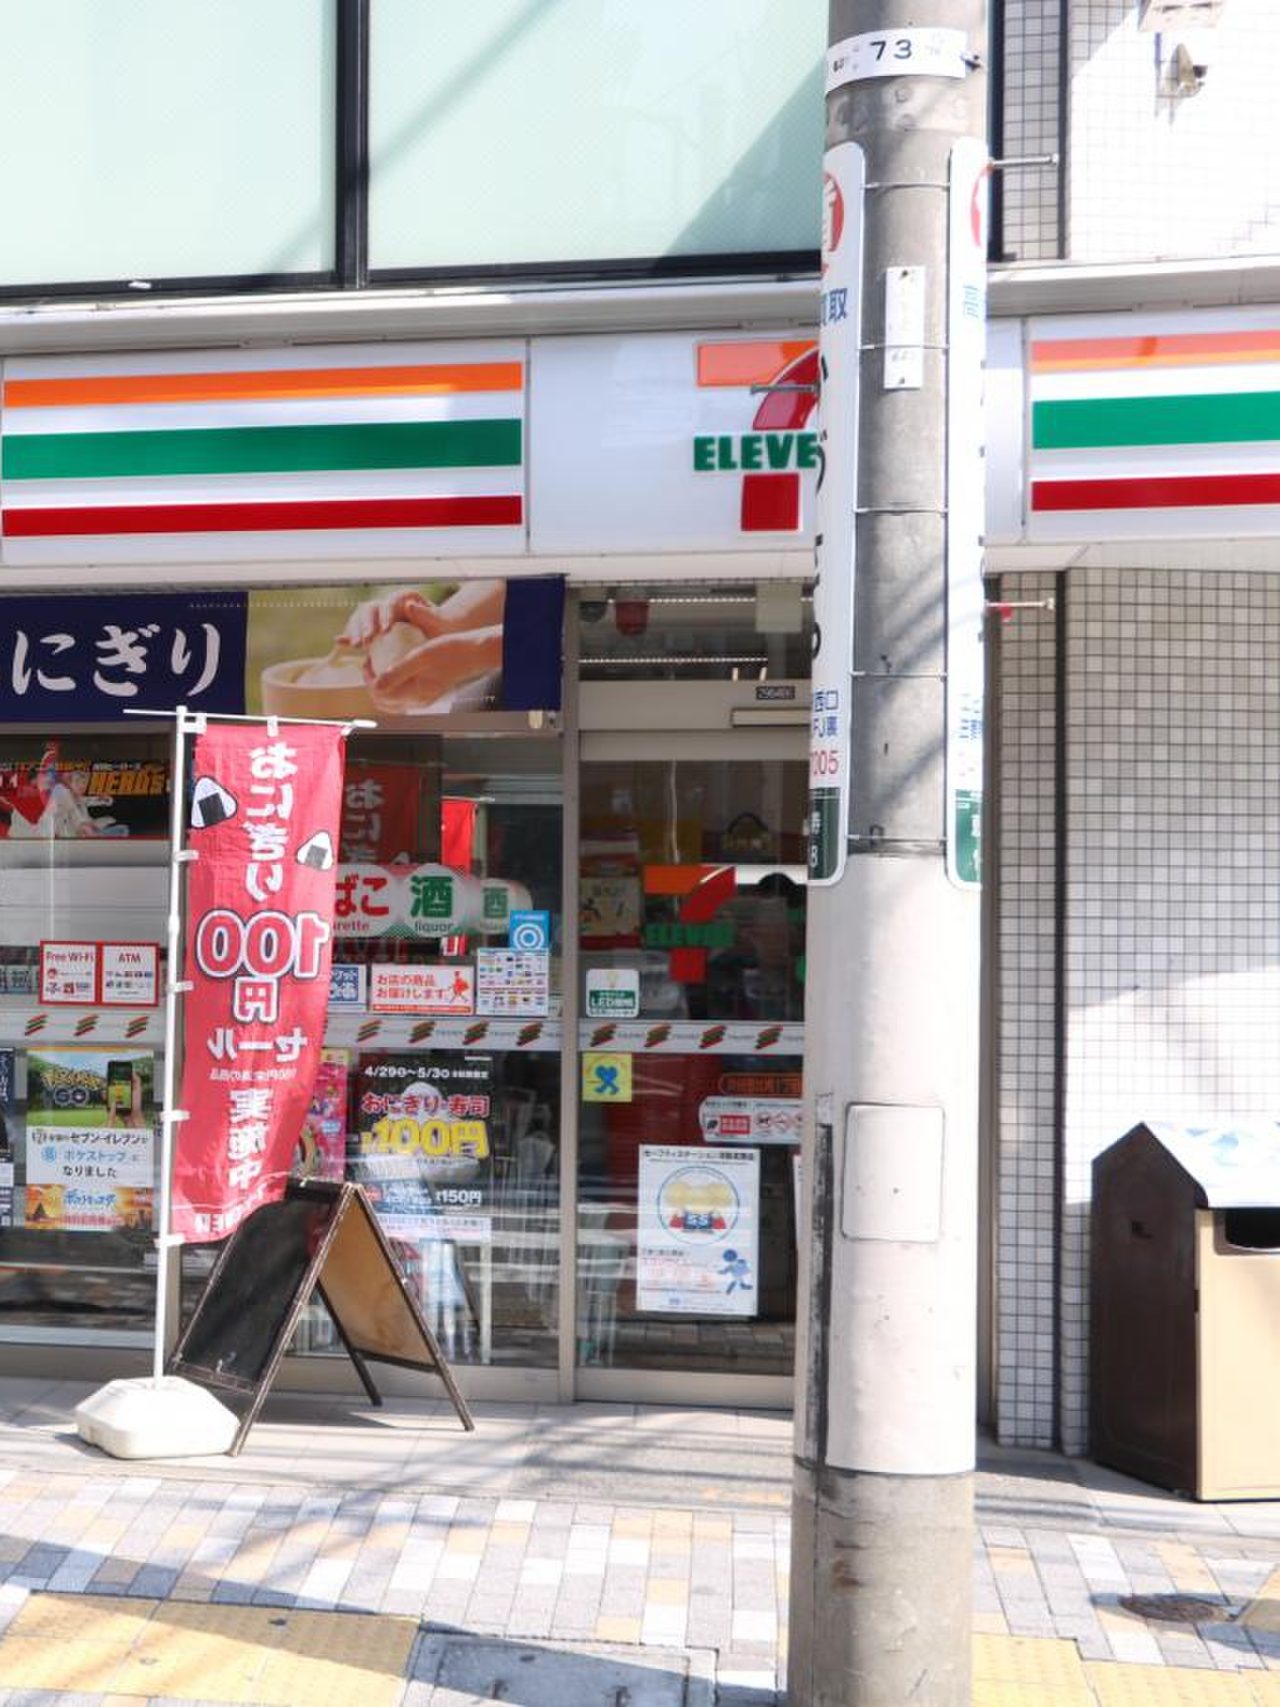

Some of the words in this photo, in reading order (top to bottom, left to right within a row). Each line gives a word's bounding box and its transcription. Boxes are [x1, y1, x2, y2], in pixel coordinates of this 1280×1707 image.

[869, 39, 913, 61] 73
[693, 431, 818, 472] ELEVE
[335, 873, 389, 917] ばこ
[410, 875, 453, 918] 酒
[333, 920, 370, 932] rette
[414, 920, 454, 934] liquor
[46, 951, 66, 962] Free
[67, 951, 94, 963] Wi-Fi
[118, 952, 141, 963] ATM
[54, 1087, 90, 1106] GO
[373, 1116, 490, 1160] 100円
[62, 1165, 118, 1178] なりました
